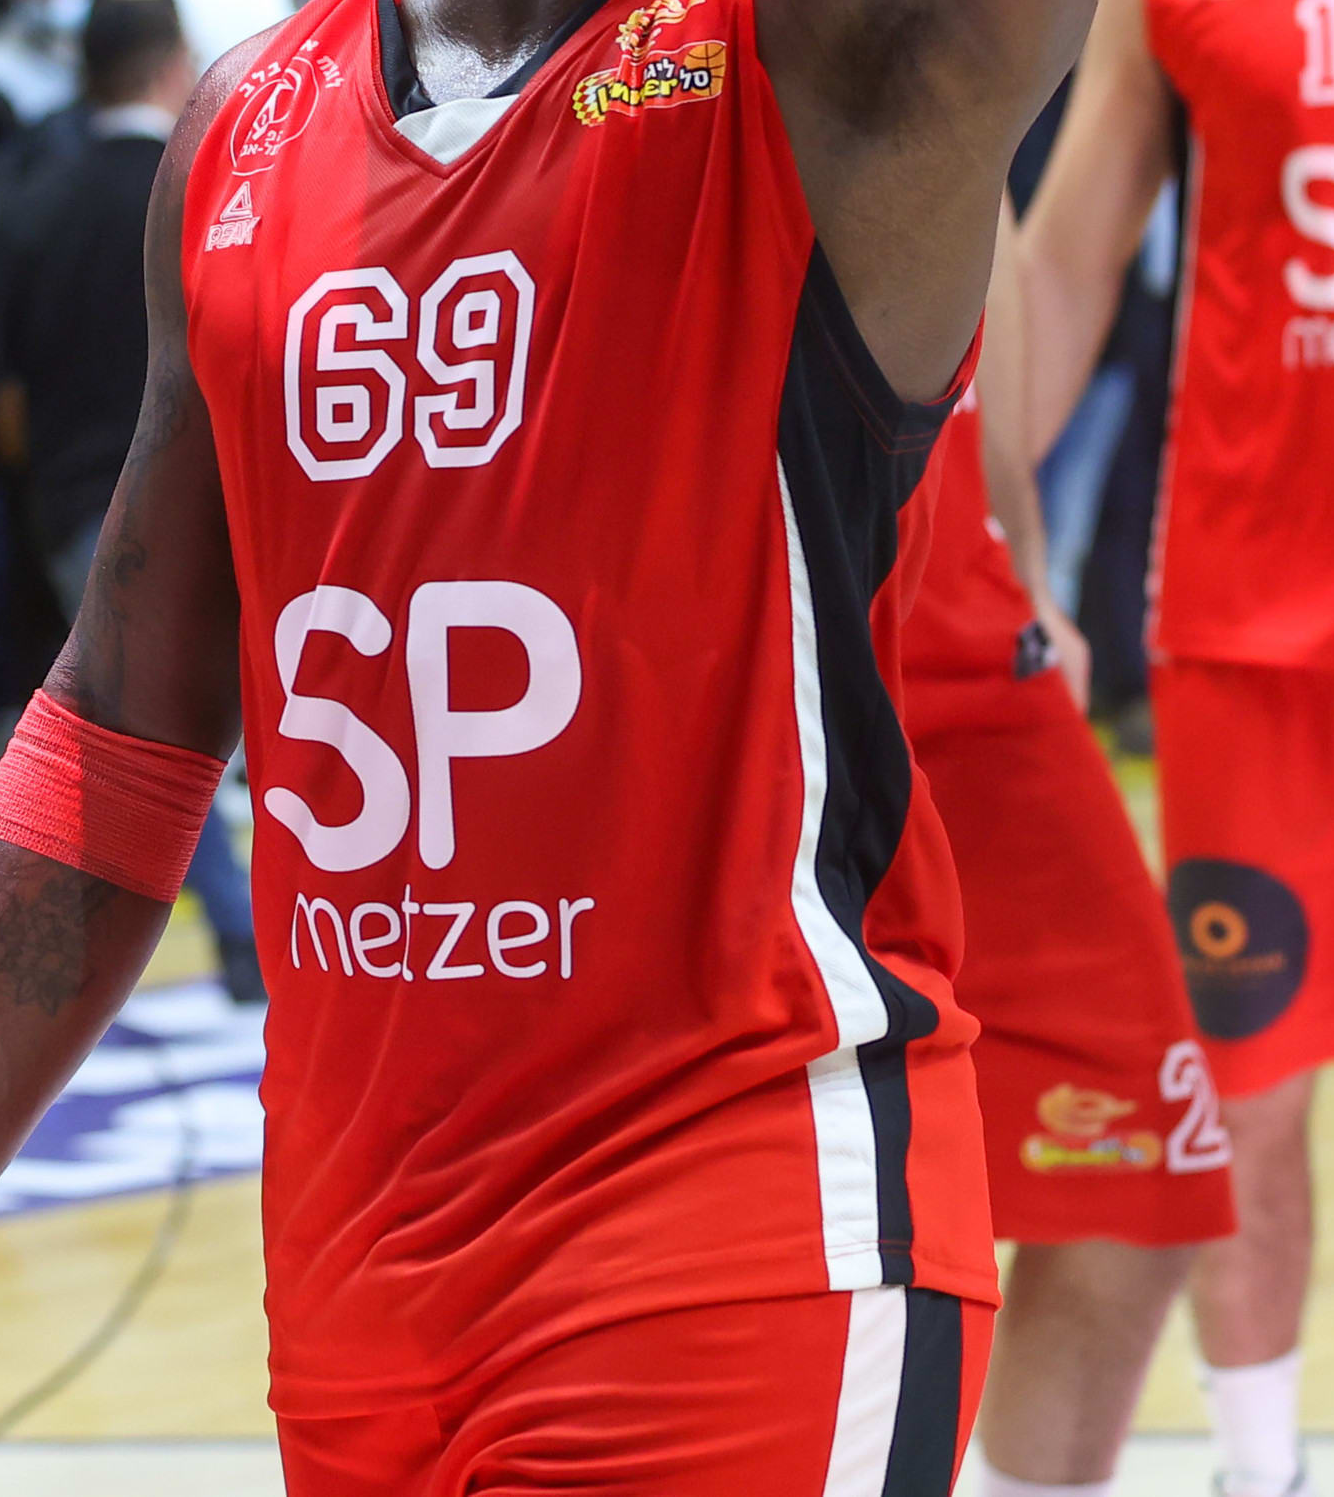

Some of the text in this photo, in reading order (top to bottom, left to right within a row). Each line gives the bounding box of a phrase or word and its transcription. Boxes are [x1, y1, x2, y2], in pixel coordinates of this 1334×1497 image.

[204, 215, 261, 253] PEAK
[284, 249, 536, 481] 69
[264, 580, 583, 874] SP
[291, 883, 596, 982] metzer
